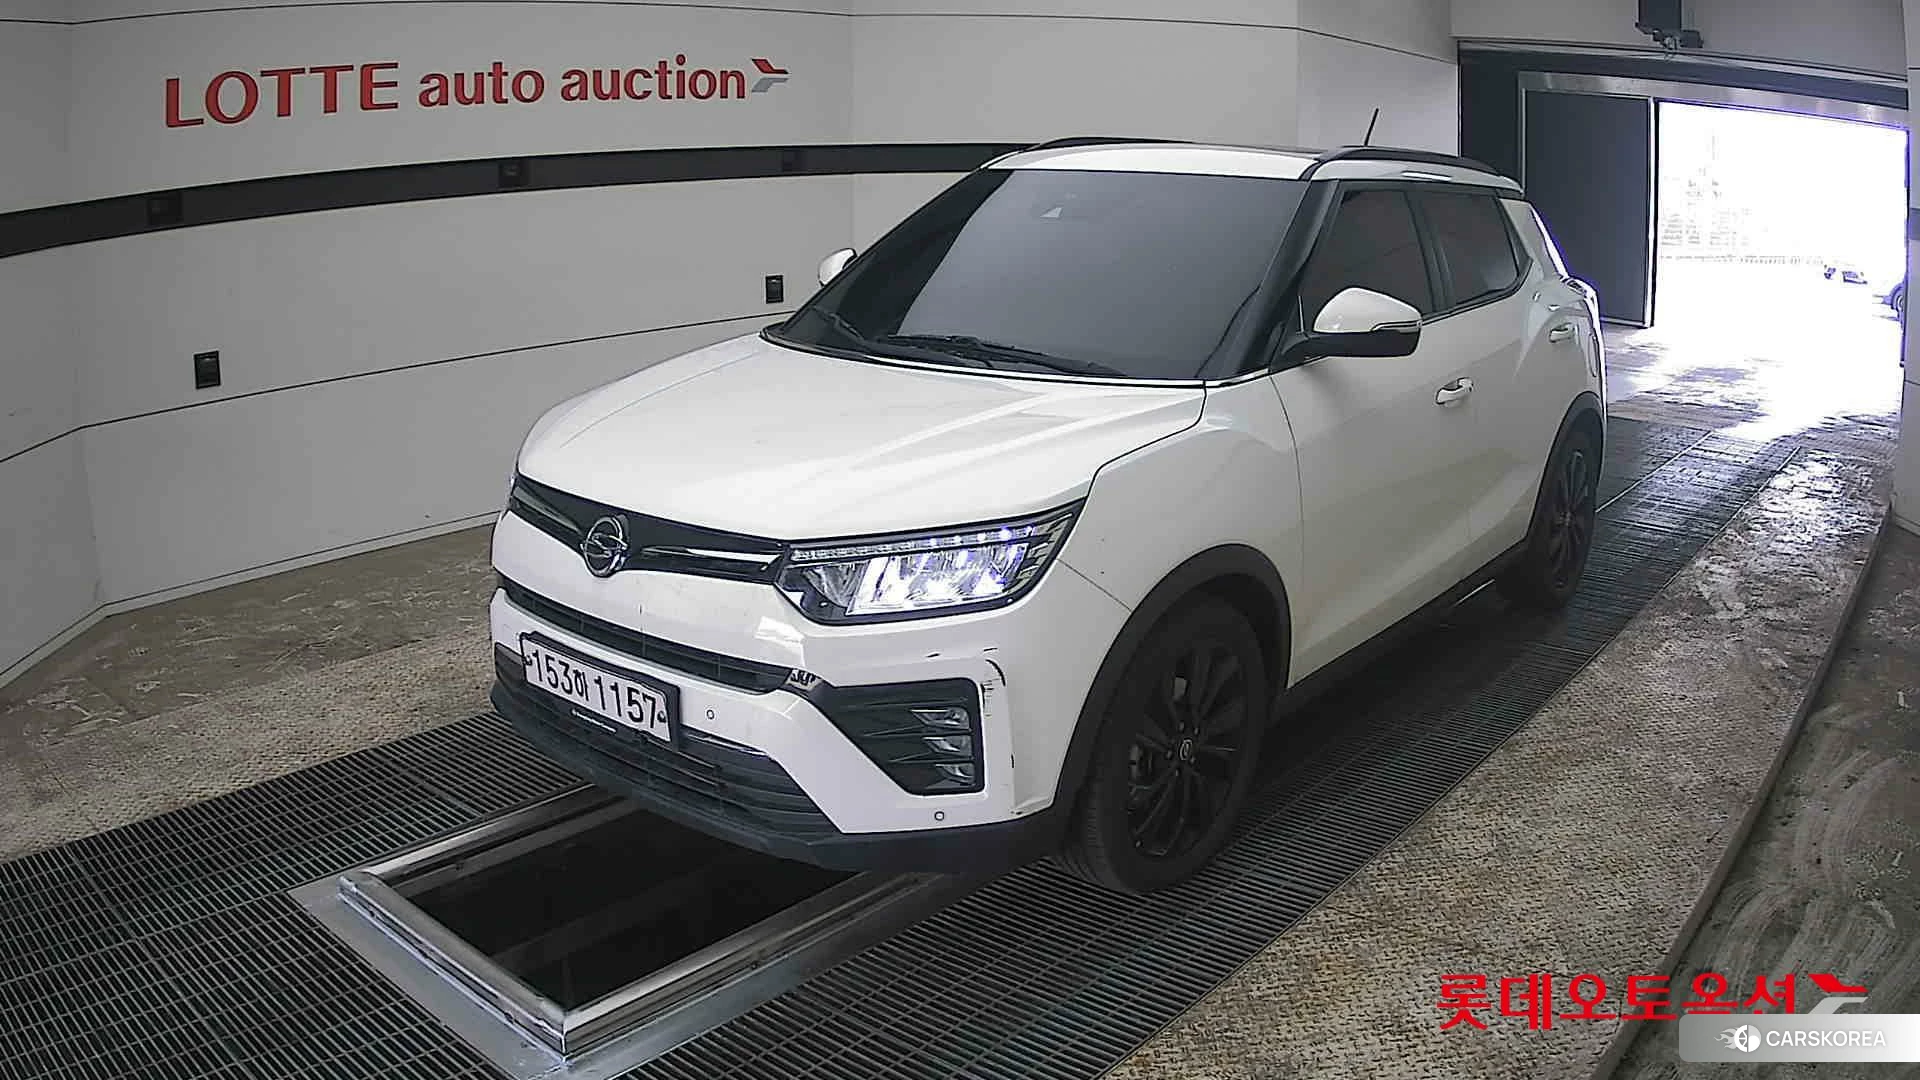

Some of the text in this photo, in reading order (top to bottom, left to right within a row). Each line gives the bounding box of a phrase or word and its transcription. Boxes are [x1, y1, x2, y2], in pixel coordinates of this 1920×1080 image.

[165, 54, 746, 128] LOTTE auto auction
[594, 675, 657, 729] 1157
